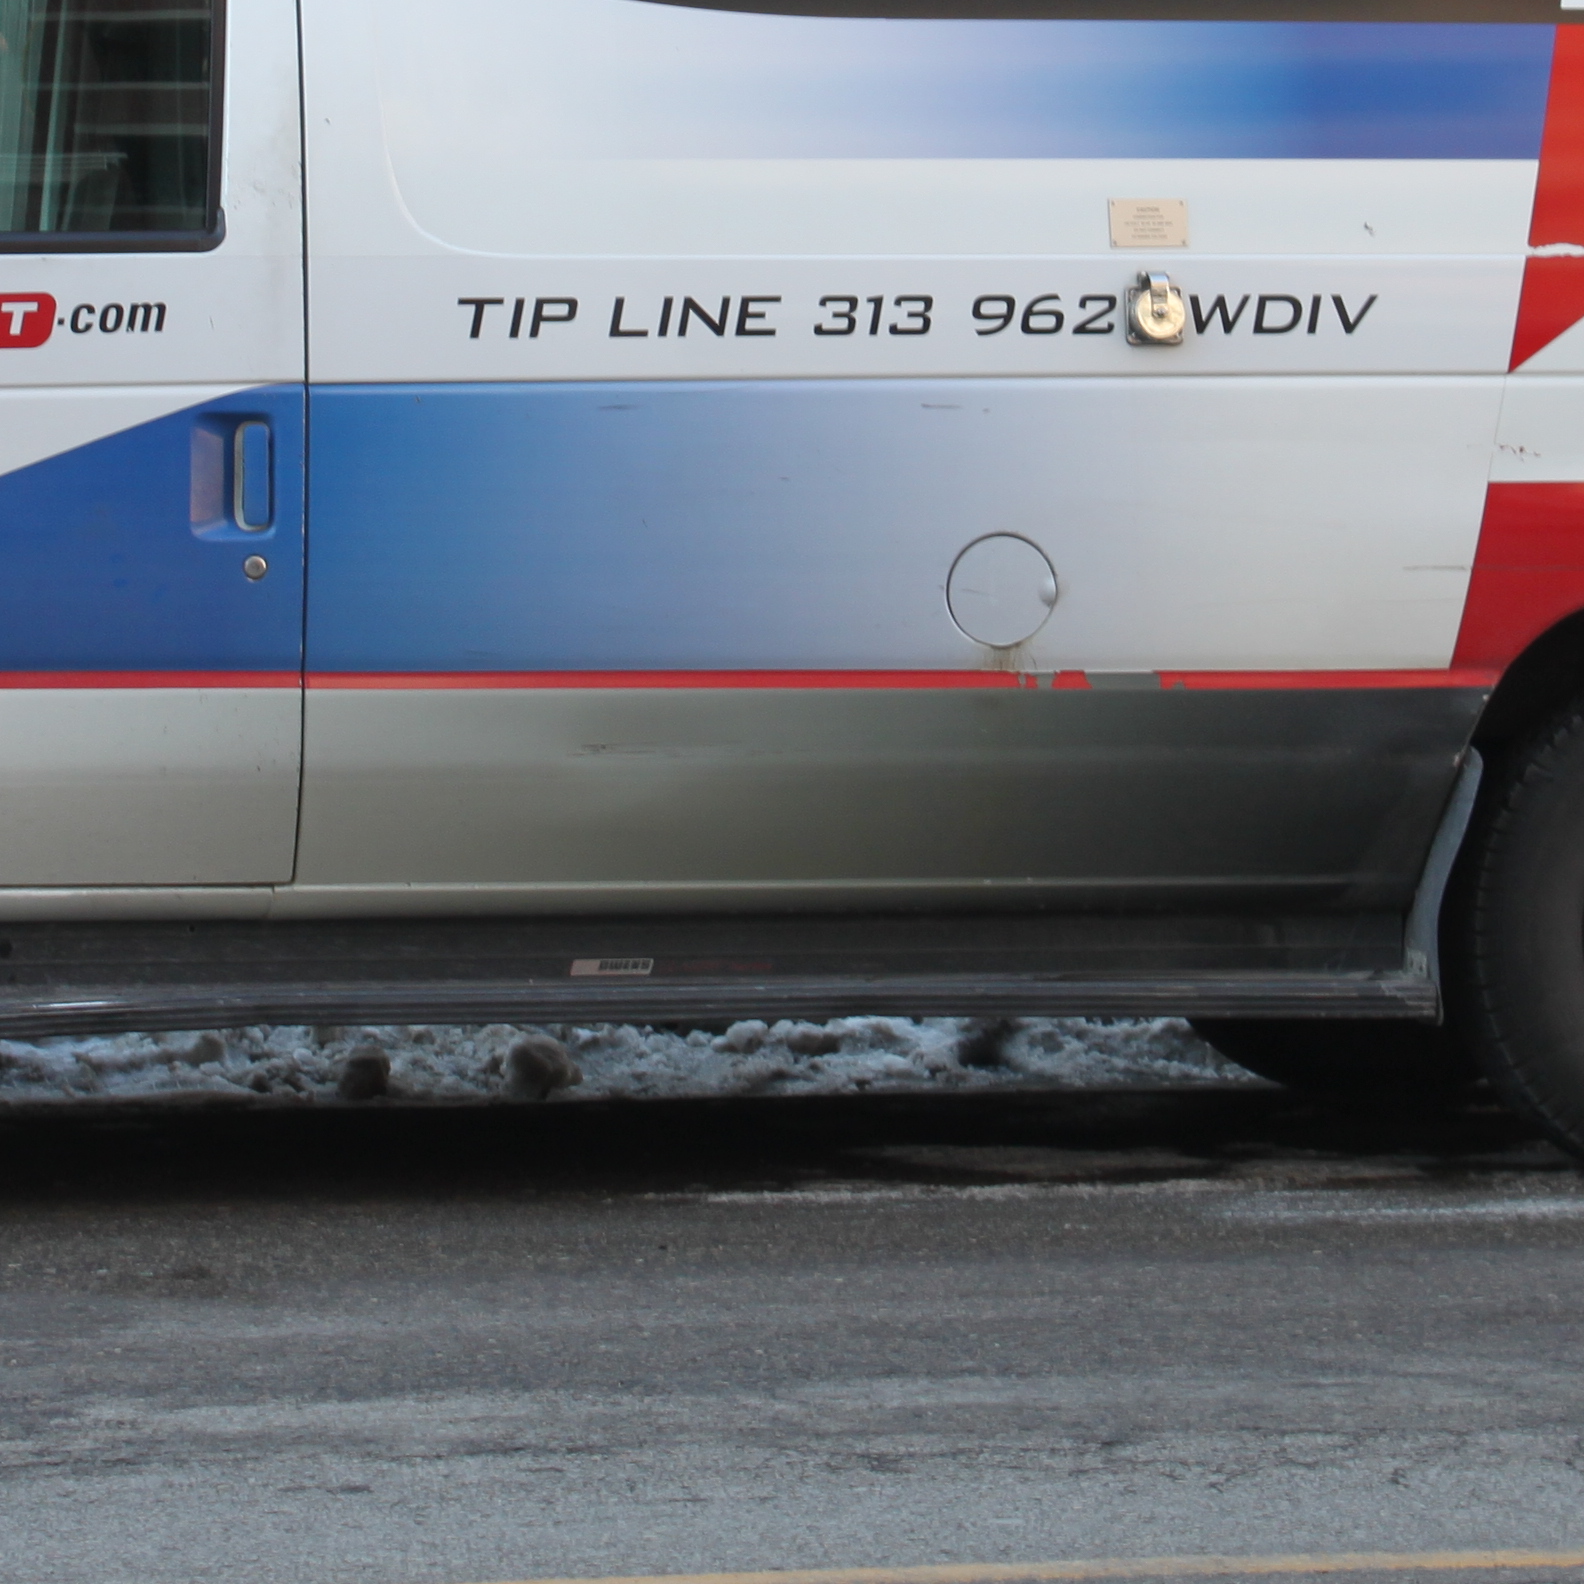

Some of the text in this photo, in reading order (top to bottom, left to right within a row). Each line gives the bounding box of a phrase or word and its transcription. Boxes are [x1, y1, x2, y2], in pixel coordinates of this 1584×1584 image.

[458, 294, 1377, 339] TIP LINE 313 962 WDIV
